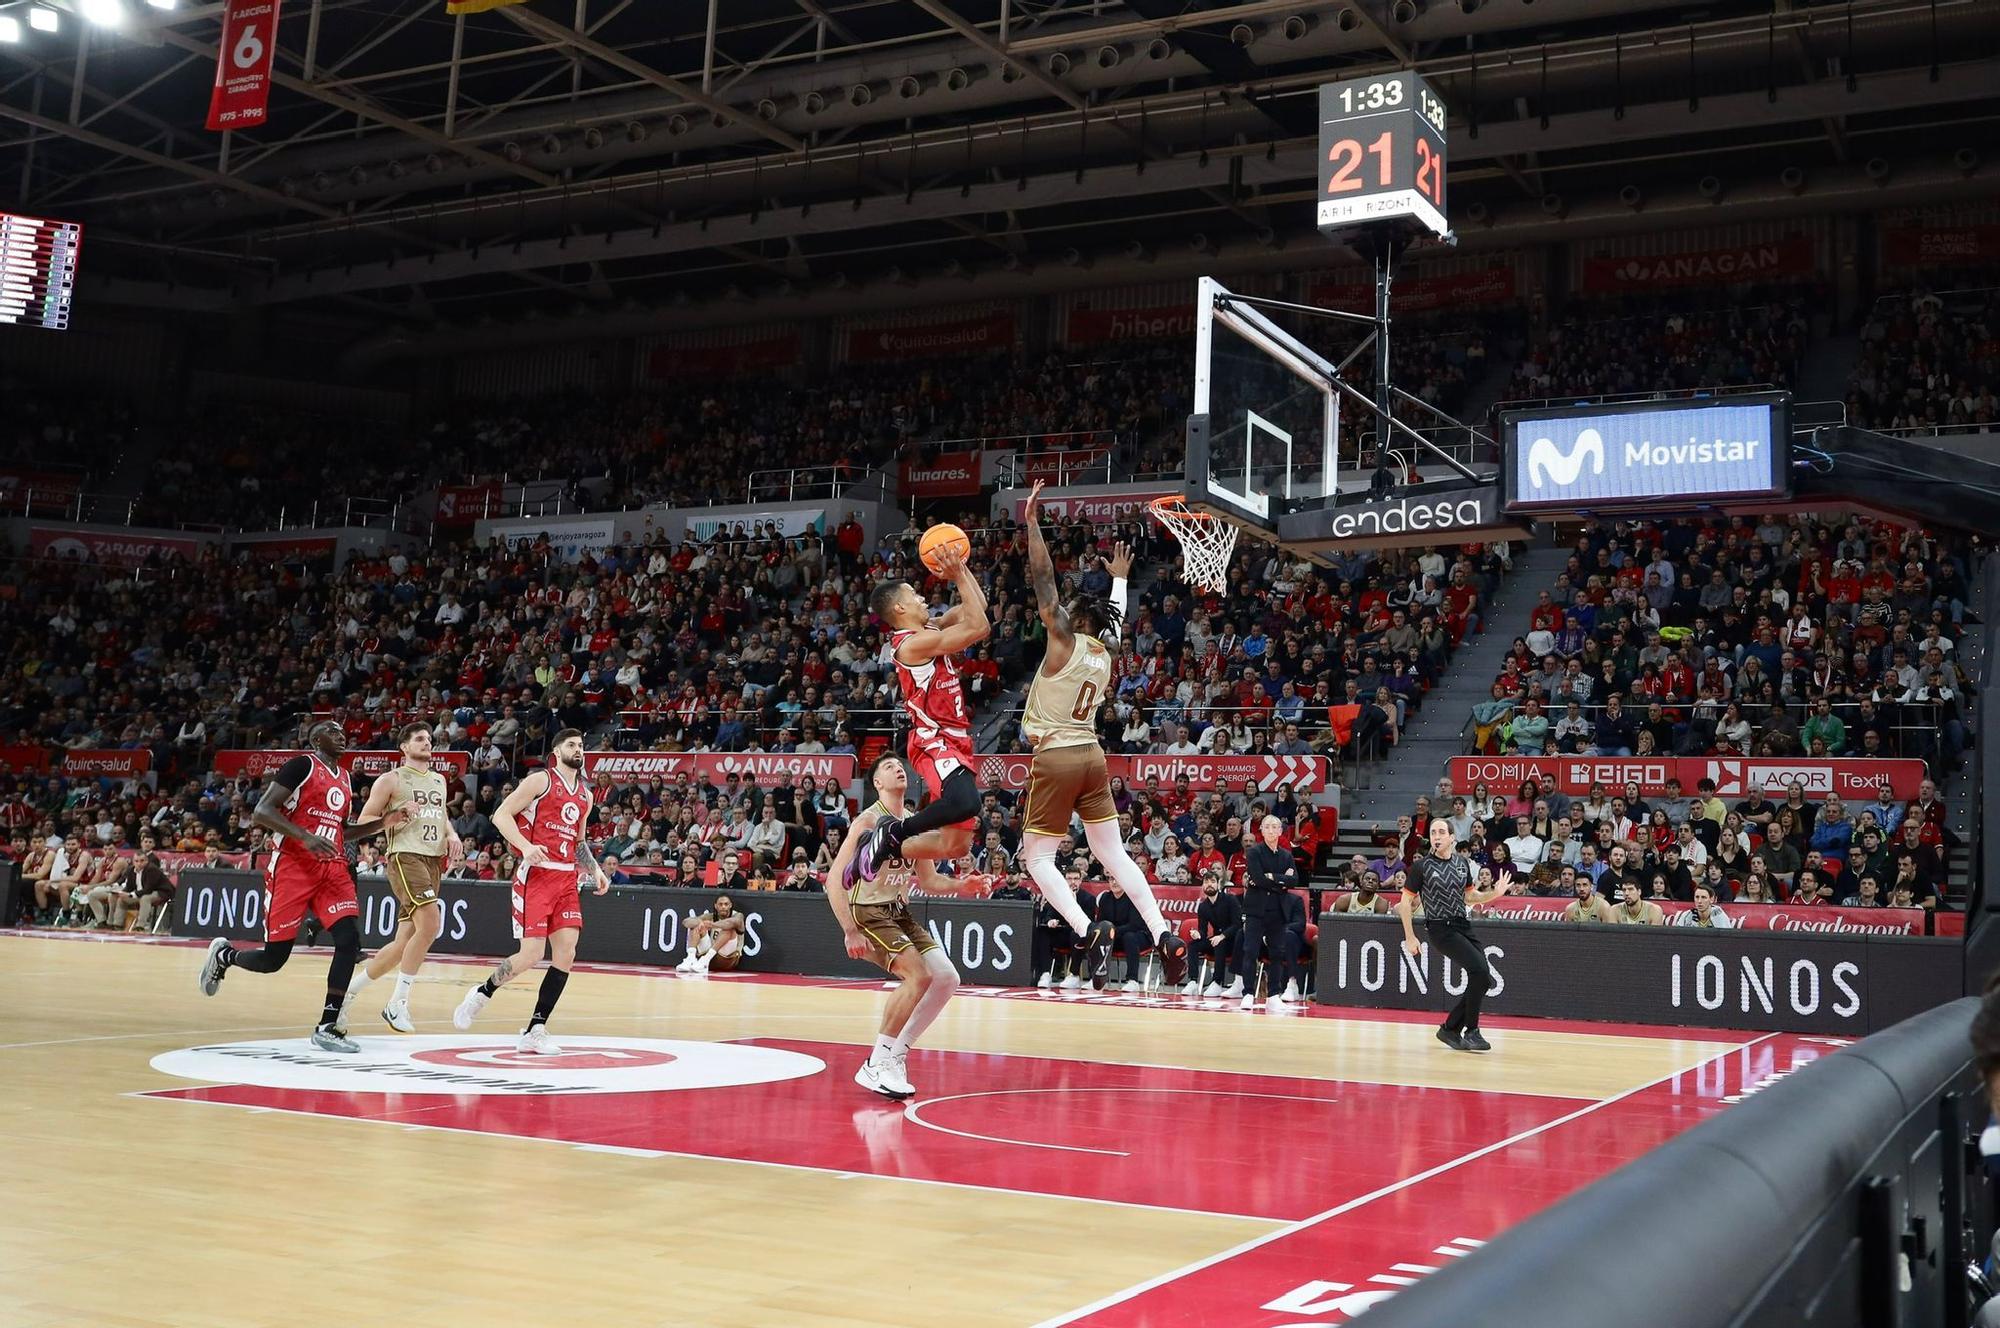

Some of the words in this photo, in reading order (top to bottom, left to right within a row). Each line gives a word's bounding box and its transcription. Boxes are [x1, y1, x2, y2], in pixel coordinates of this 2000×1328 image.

[233, 24, 263, 69] 6
[1339, 80, 1403, 112] 1:33
[1420, 89, 1444, 131] 1:33
[1327, 131, 1393, 194] 21
[1416, 137, 1441, 206] 21
[1652, 248, 1779, 280] ANAGAN
[1110, 313, 1196, 339] hiberu
[1625, 437, 1759, 467] Movistar
[908, 466, 971, 482] lunares.
[1332, 499, 1482, 538] endesa
[954, 695, 964, 718] 2
[1071, 680, 1098, 722] 0
[593, 758, 681, 773] MERCURY
[742, 757, 833, 776] ANAGAN
[1136, 758, 1212, 783] levitec
[1217, 765, 1257, 773] SUMAMOS
[1467, 763, 1543, 781] DOMIA
[1752, 772, 1826, 788] LACOR
[1838, 771, 1889, 789] Textil
[412, 790, 442, 807] BG
[422, 824, 438, 842] 23
[560, 840, 568, 858] 4
[184, 887, 262, 929] IONO
[1768, 912, 1913, 935] Casademont
[1671, 953, 1861, 1018] IONOS
